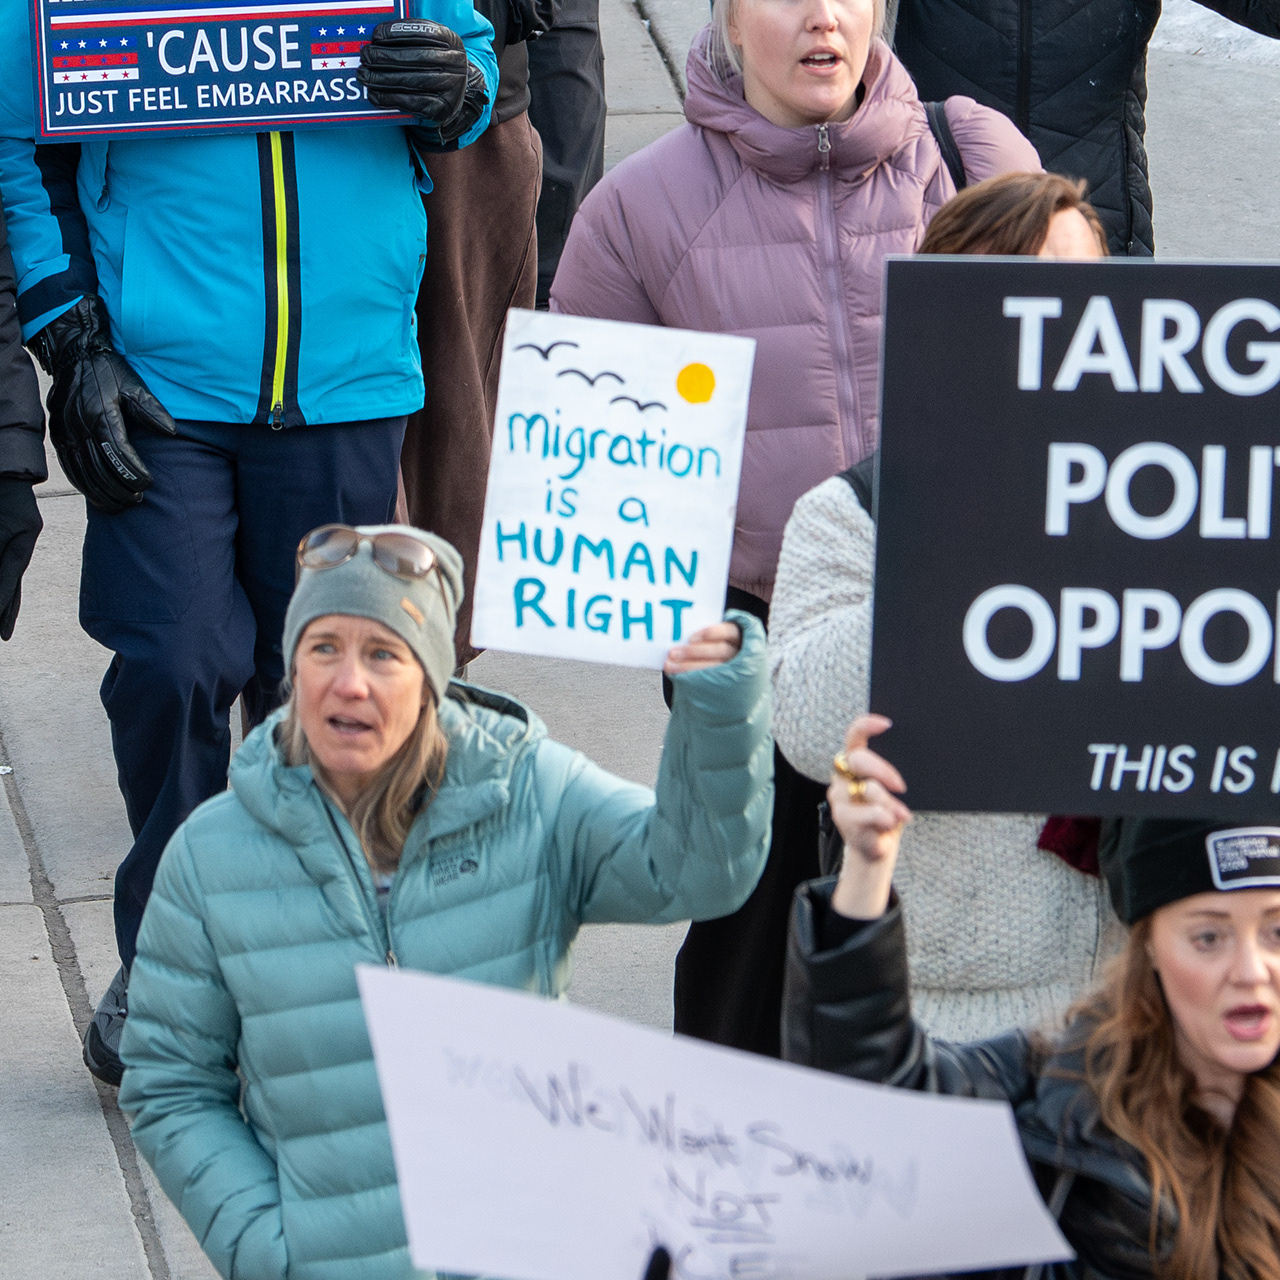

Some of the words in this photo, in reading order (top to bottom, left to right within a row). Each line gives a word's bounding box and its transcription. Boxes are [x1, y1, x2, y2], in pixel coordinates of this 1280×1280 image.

[146, 24, 302, 76] 'CAUSE
[390, 22, 438, 33] SCOTT
[55, 89, 119, 116] JUST
[128, 85, 187, 112] FEEL
[197, 76, 368, 108] EMBARRASS
[508, 408, 722, 481] migration
[546, 479, 579, 519] is
[618, 497, 649, 528] a
[496, 520, 699, 588] HUMAN
[513, 577, 695, 642] RIGHT
[1087, 743, 1198, 793] THIS
[1209, 745, 1258, 795] IS
